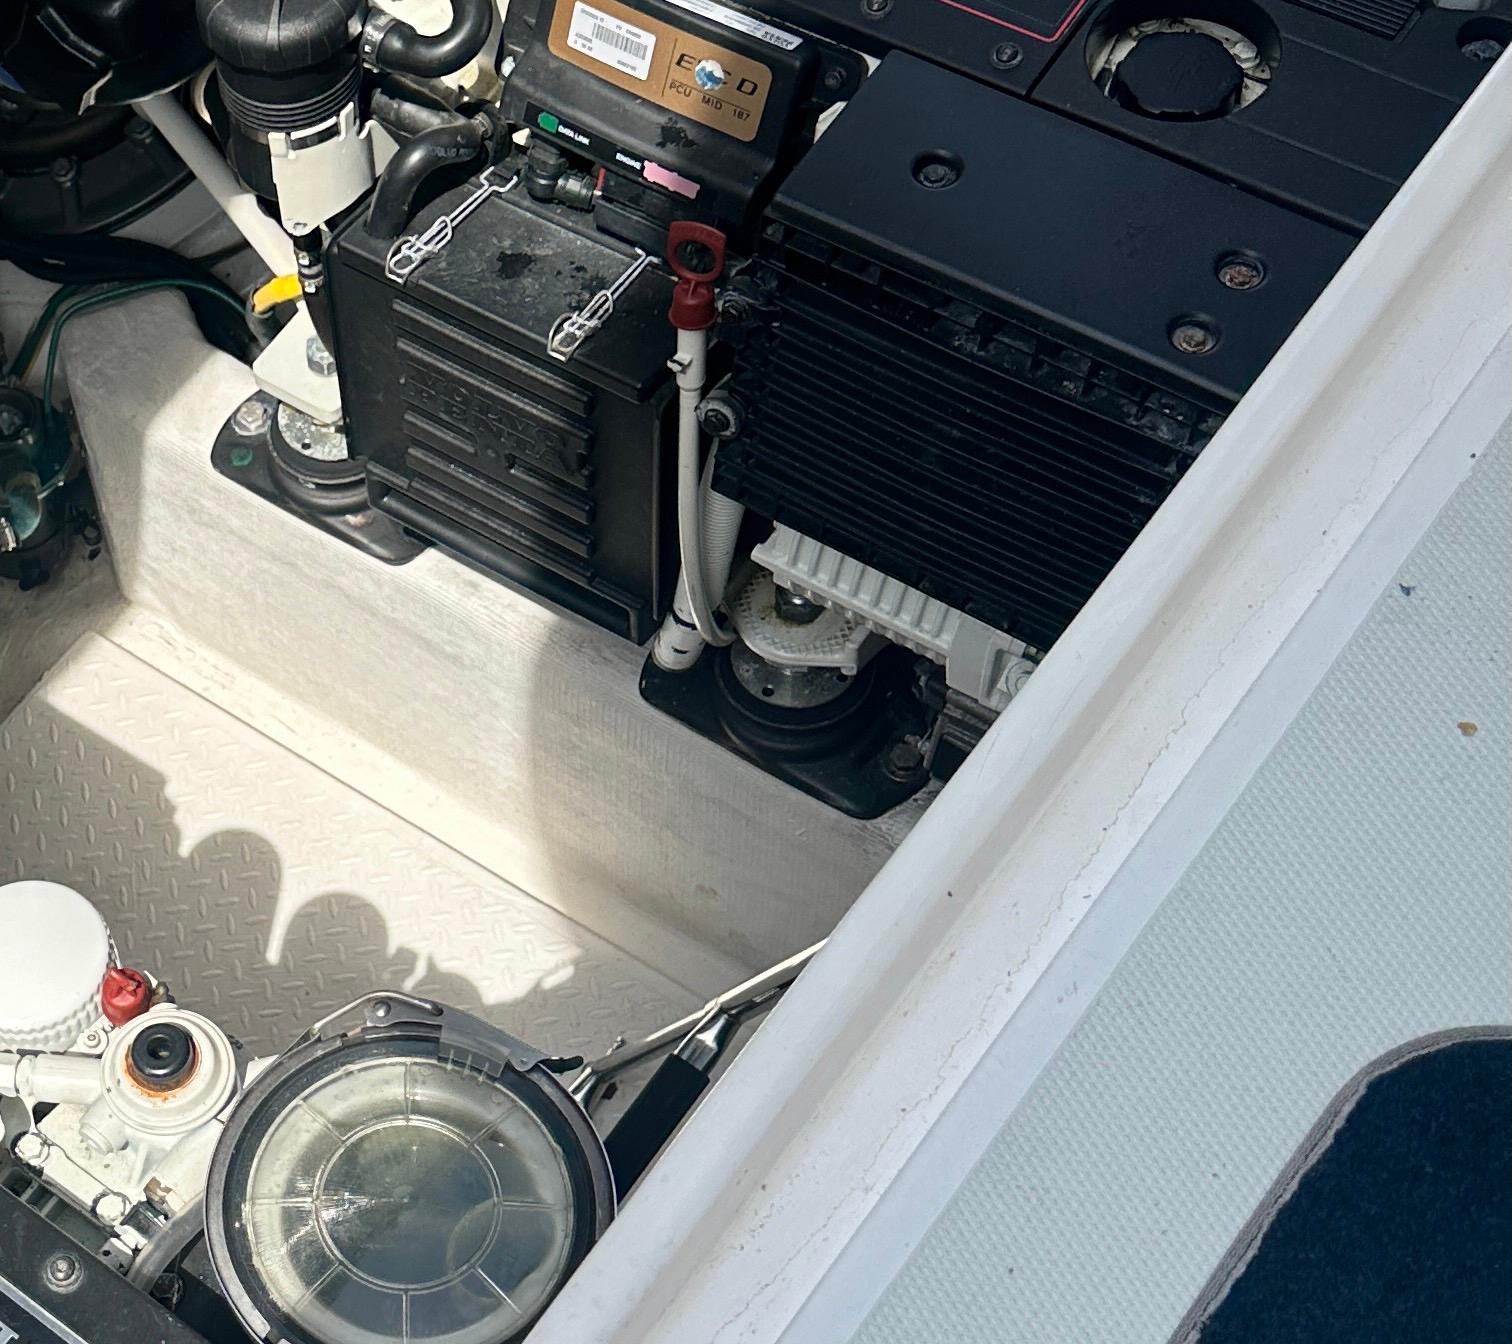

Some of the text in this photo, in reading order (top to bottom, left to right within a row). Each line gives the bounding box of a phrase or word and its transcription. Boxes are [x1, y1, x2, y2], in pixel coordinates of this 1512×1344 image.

[669, 82, 750, 121] PCU MID 187
[557, 124, 589, 145] DATA LINK
[615, 152, 641, 170] ENGINE
